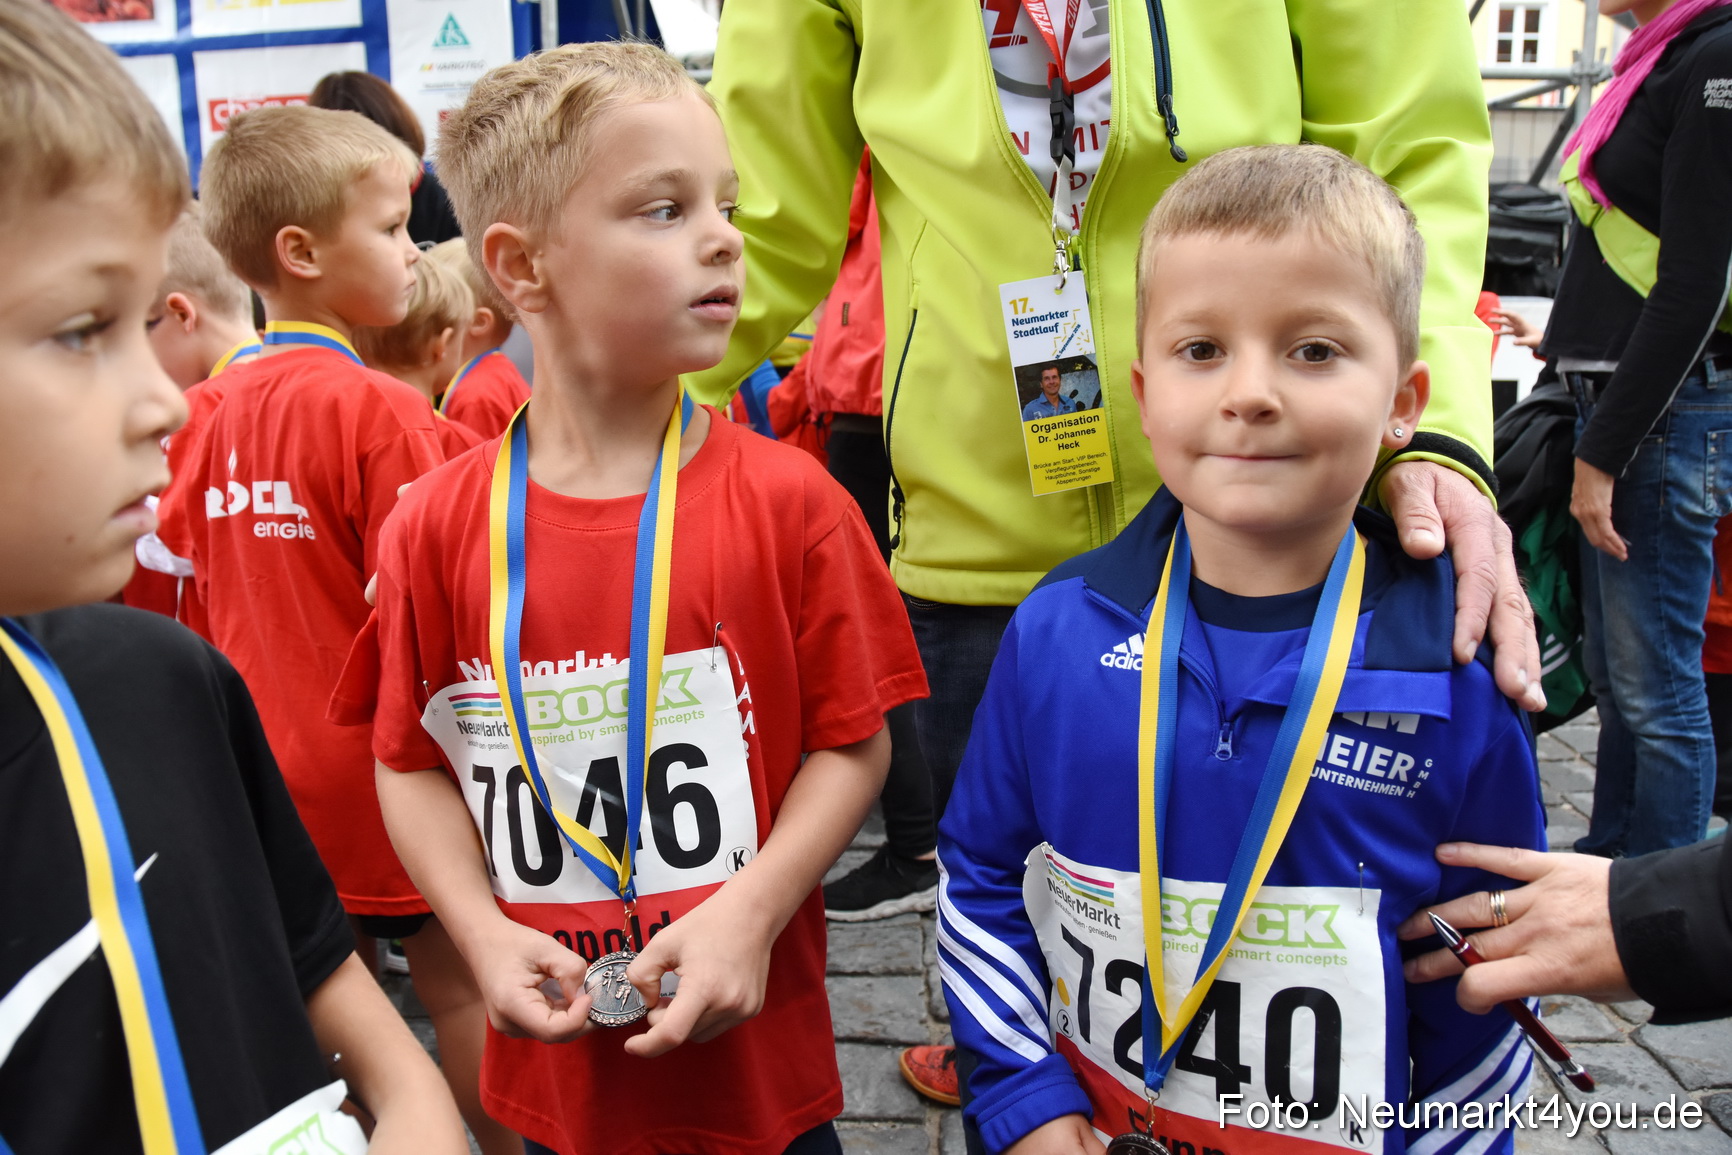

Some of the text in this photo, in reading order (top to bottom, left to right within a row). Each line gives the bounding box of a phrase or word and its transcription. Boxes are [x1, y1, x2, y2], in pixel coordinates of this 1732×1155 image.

[1027, 0, 1055, 35] WEAR
[1009, 297, 1034, 316] 17.
[1012, 310, 1069, 327] Neumarkter
[1013, 322, 1059, 339] Stadtlauf
[1031, 414, 1100, 434] Organisation
[1038, 427, 1096, 444] Dr. Johannes
[1058, 440, 1080, 451] Heck
[1034, 461, 1051, 470] Brücke
[1056, 474, 1092, 486] Absperrungen
[530, 709, 705, 747] nspired by sma oncepts
[472, 743, 722, 886] 7046
[733, 849, 746, 872] K
[1046, 877, 1121, 930] NeuerMarkt
[1162, 893, 1346, 949] BOCK
[1088, 925, 1117, 942] genießen
[1163, 938, 1347, 967] pired smart concepts
[1061, 922, 1342, 1121] 7240
[1062, 1014, 1070, 1034] 2
[1349, 1121, 1363, 1145] K
